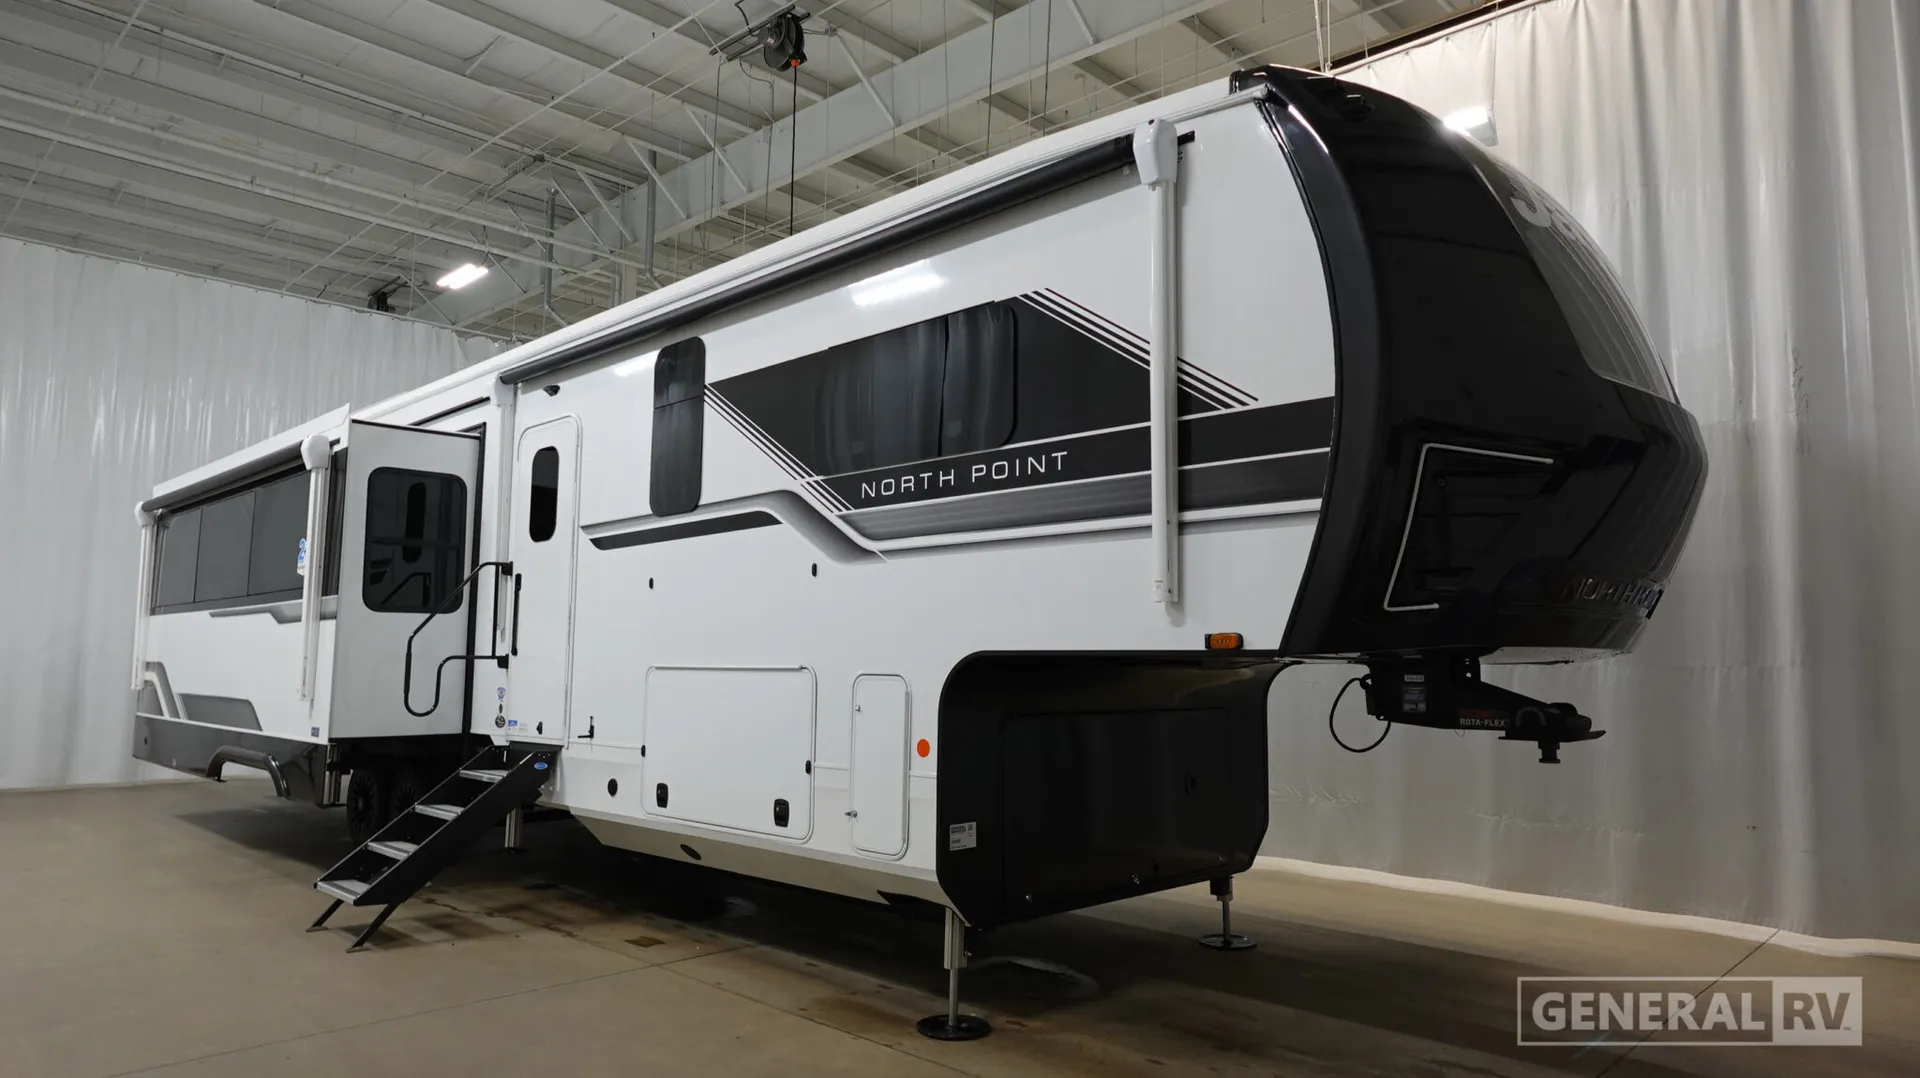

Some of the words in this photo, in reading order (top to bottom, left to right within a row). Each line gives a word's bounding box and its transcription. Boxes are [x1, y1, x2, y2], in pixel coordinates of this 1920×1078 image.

[861, 468, 954, 499] NORTH
[972, 451, 1068, 483] POINT
[1459, 718, 1506, 727] ROTA-FLEX
